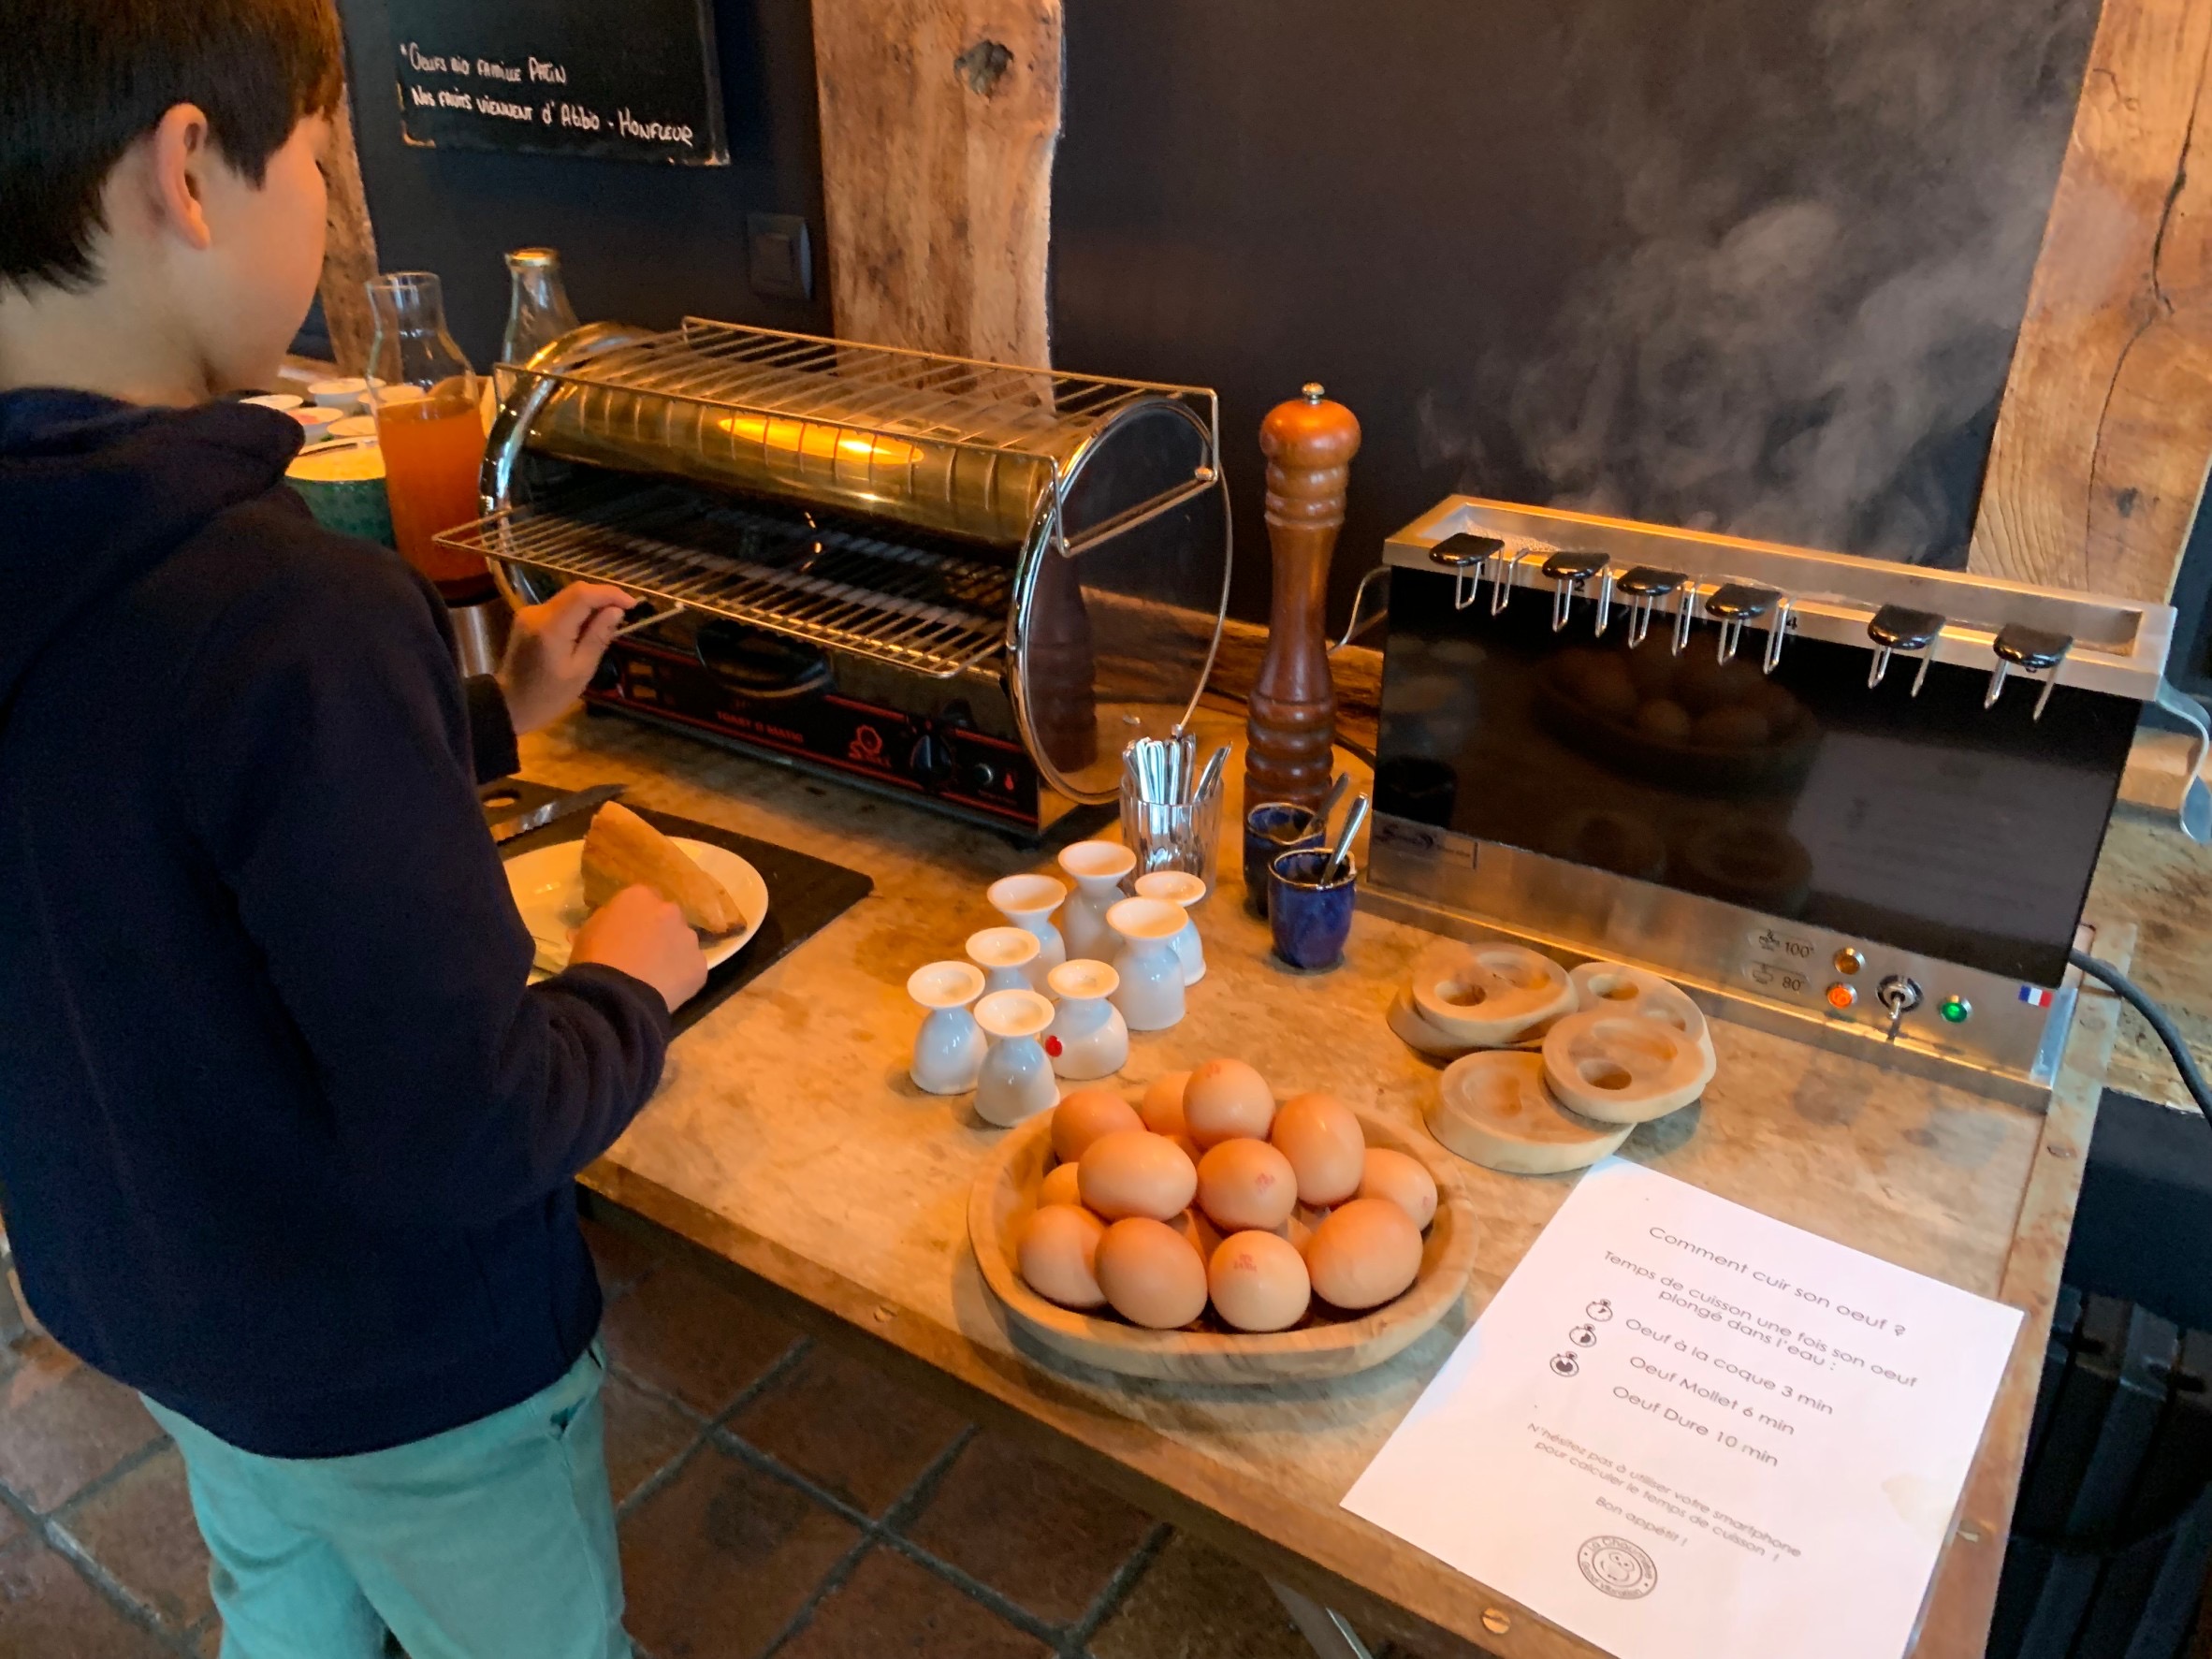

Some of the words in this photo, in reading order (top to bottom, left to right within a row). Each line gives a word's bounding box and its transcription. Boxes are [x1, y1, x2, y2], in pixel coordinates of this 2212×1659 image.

[1604, 1250, 1656, 1280] Temps
[1660, 1275, 1684, 1291] de
[1688, 1288, 1753, 1320] cuisson
[1757, 1317, 1792, 1337] une
[1797, 1332, 1828, 1352] fois
[1831, 1348, 1865, 1368] son
[1870, 1364, 1918, 1388] oeuf
[1649, 1226, 1749, 1273] Comment
[1753, 1271, 1791, 1291] cuir
[1795, 1288, 1830, 1308] son
[1836, 1305, 1888, 1331] oeuf
[1894, 1324, 1907, 1337] ?
[1658, 1290, 1723, 1322] plongé
[1727, 1318, 1772, 1345] dans
[1776, 1337, 1826, 1366] l'eau
[1625, 1318, 1672, 1345] Oeuf
[1674, 1339, 1687, 1353] à
[1691, 1346, 1710, 1361] la
[1713, 1358, 1776, 1390] coque
[1781, 1385, 1794, 1398] 3
[1797, 1393, 1834, 1416] min
[1629, 1356, 1678, 1382] Oeuf
[1679, 1377, 1739, 1411] Mollet
[1742, 1406, 1754, 1418] 6
[1758, 1413, 1795, 1435] min
[1612, 1386, 1662, 1413] Oeuf
[1663, 1407, 1710, 1436] Dure
[1717, 1431, 1739, 1448] 10
[1741, 1444, 1779, 1467] min
[1534, 1441, 1568, 1459] pour
[1569, 1457, 1625, 1486] calculer
[1625, 1482, 1640, 1494] le
[1643, 1490, 1687, 1518] temps
[1689, 1515, 1710, 1528] de
[1711, 1525, 1766, 1557] cuisson
[1587, 1451, 1614, 1468] pas
[1674, 1492, 1710, 1514] votre
[1711, 1510, 1802, 1557] smartphone
[1594, 1495, 1623, 1515] Bon
